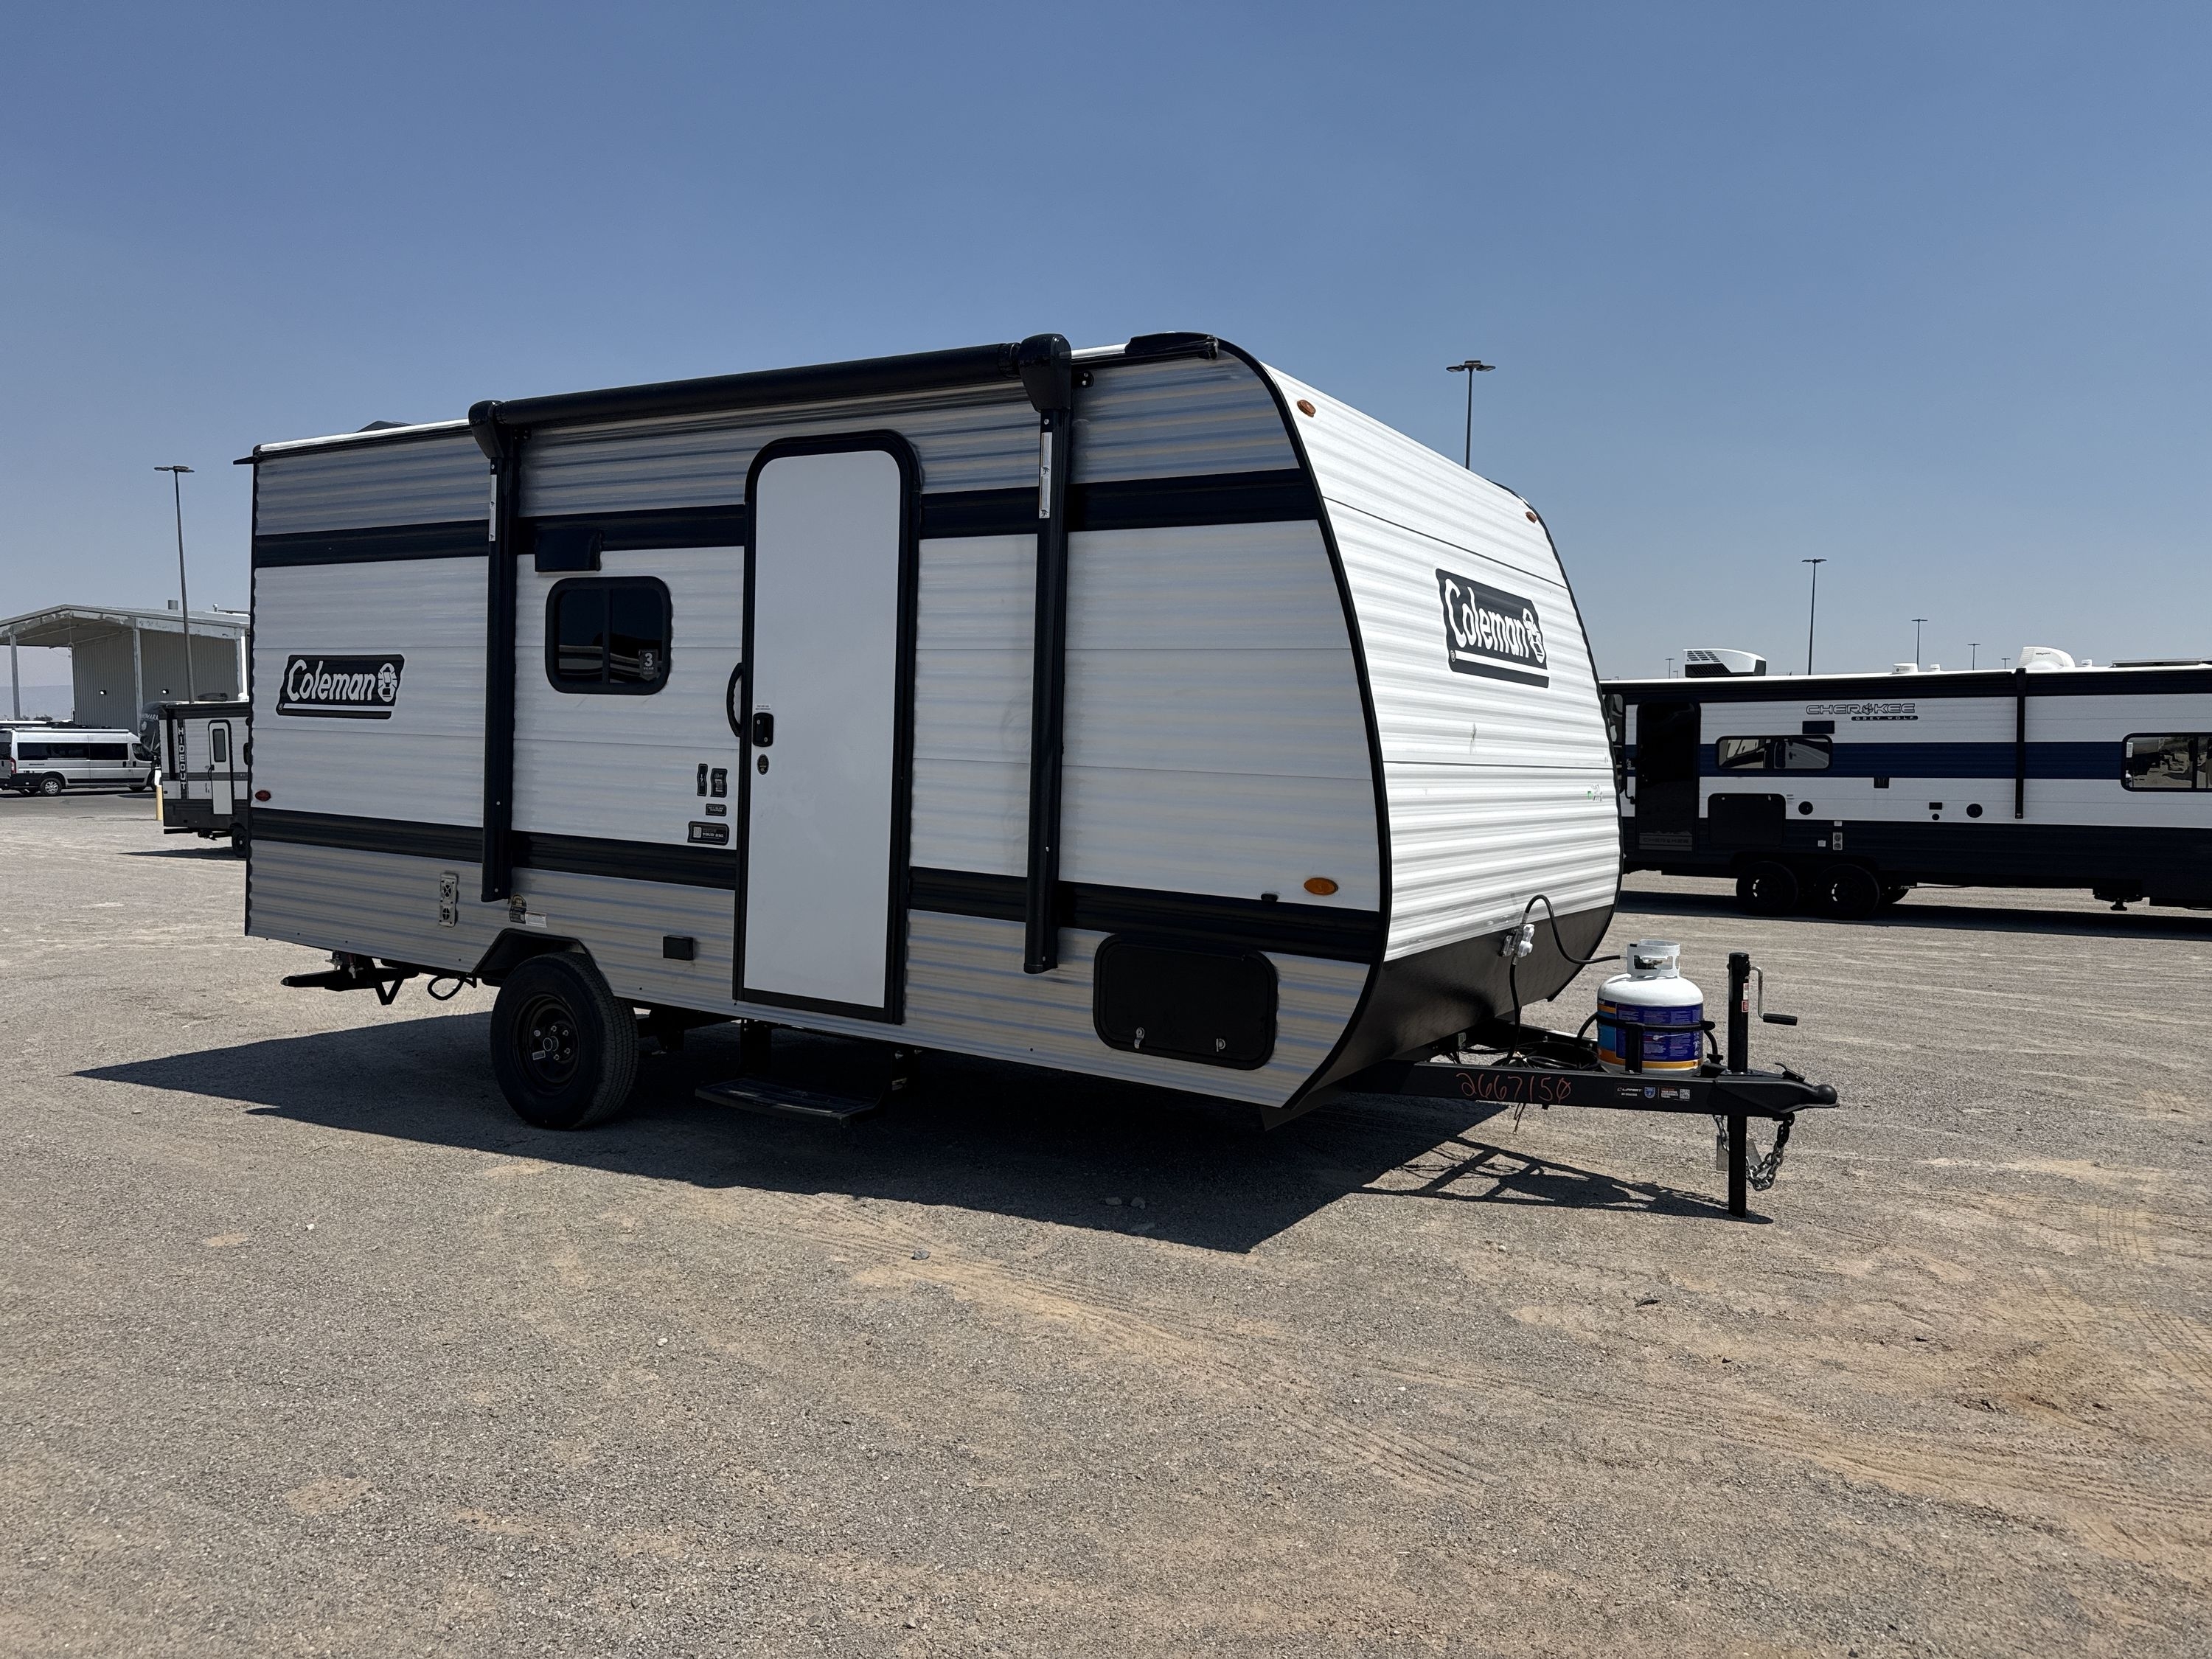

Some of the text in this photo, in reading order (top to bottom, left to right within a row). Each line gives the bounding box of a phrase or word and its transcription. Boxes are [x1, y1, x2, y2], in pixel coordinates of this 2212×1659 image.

[1445, 579, 1528, 658] Coleman
[287, 659, 376, 701] Coleman
[644, 653, 653, 667] 3
[178, 727, 187, 790] HIDEOUT
